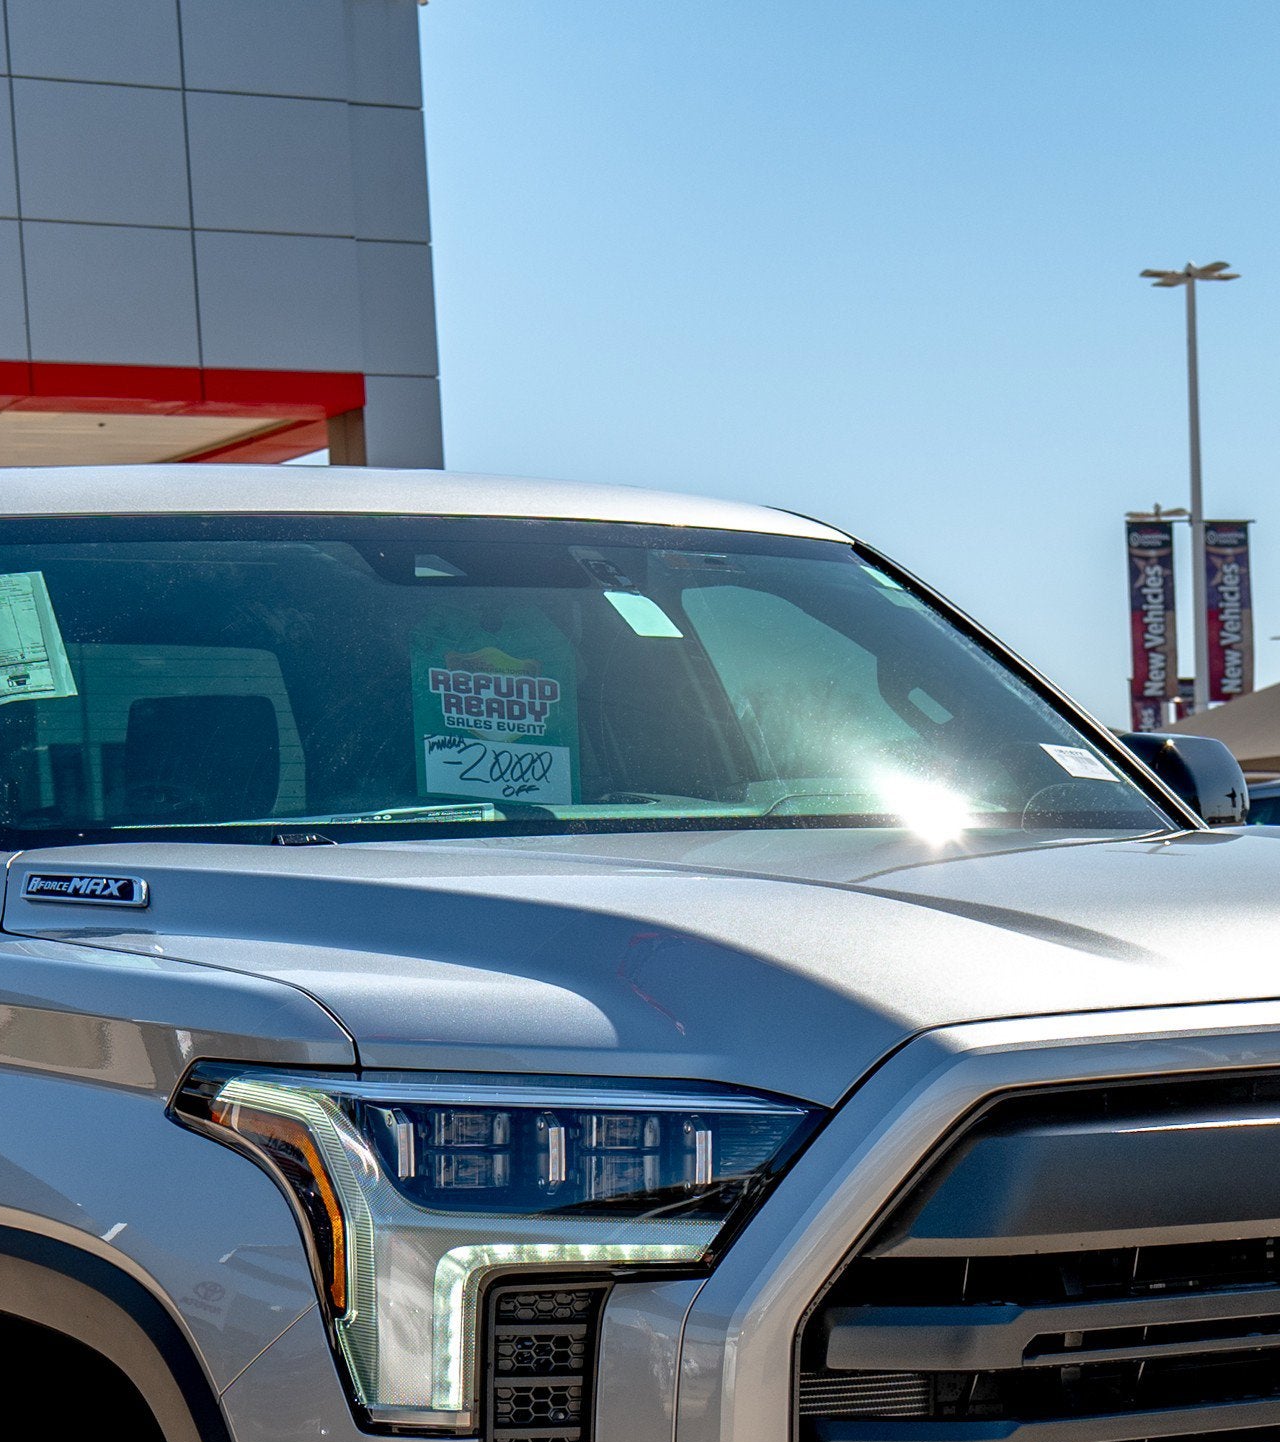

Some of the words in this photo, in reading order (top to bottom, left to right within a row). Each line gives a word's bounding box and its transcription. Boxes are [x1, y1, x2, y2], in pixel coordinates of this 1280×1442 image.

[1141, 564, 1167, 649] Vehicles
[1218, 562, 1242, 646] Vehicles
[430, 669, 559, 701] REFUND
[1143, 652, 1167, 697] New
[1221, 649, 1243, 694] New
[443, 693, 549, 722] READY
[446, 716, 493, 730] SALES
[496, 721, 545, 734] EVENT
